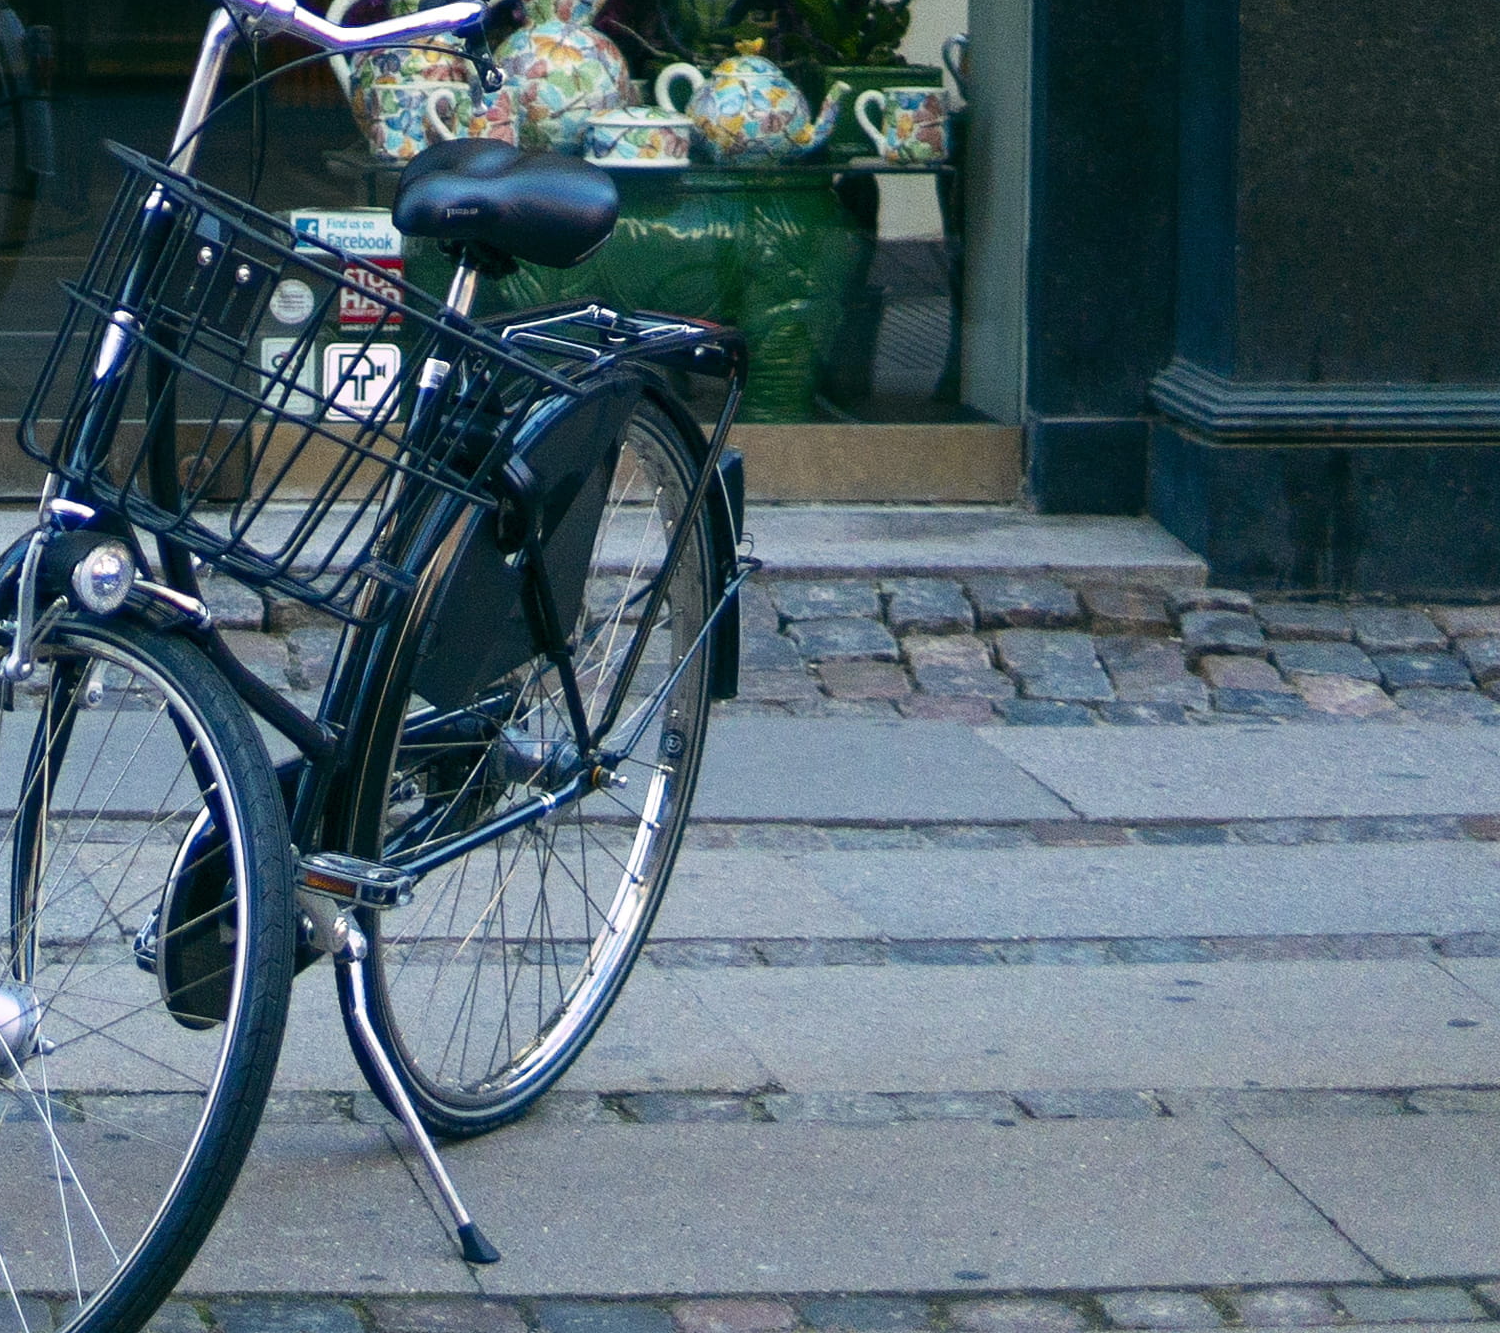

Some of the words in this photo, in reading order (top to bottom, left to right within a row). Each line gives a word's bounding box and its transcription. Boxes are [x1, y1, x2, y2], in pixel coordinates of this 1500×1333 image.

[327, 218, 347, 230] Find
[349, 221, 360, 230] us
[362, 221, 374, 230] on
[327, 232, 393, 250] Facebook
